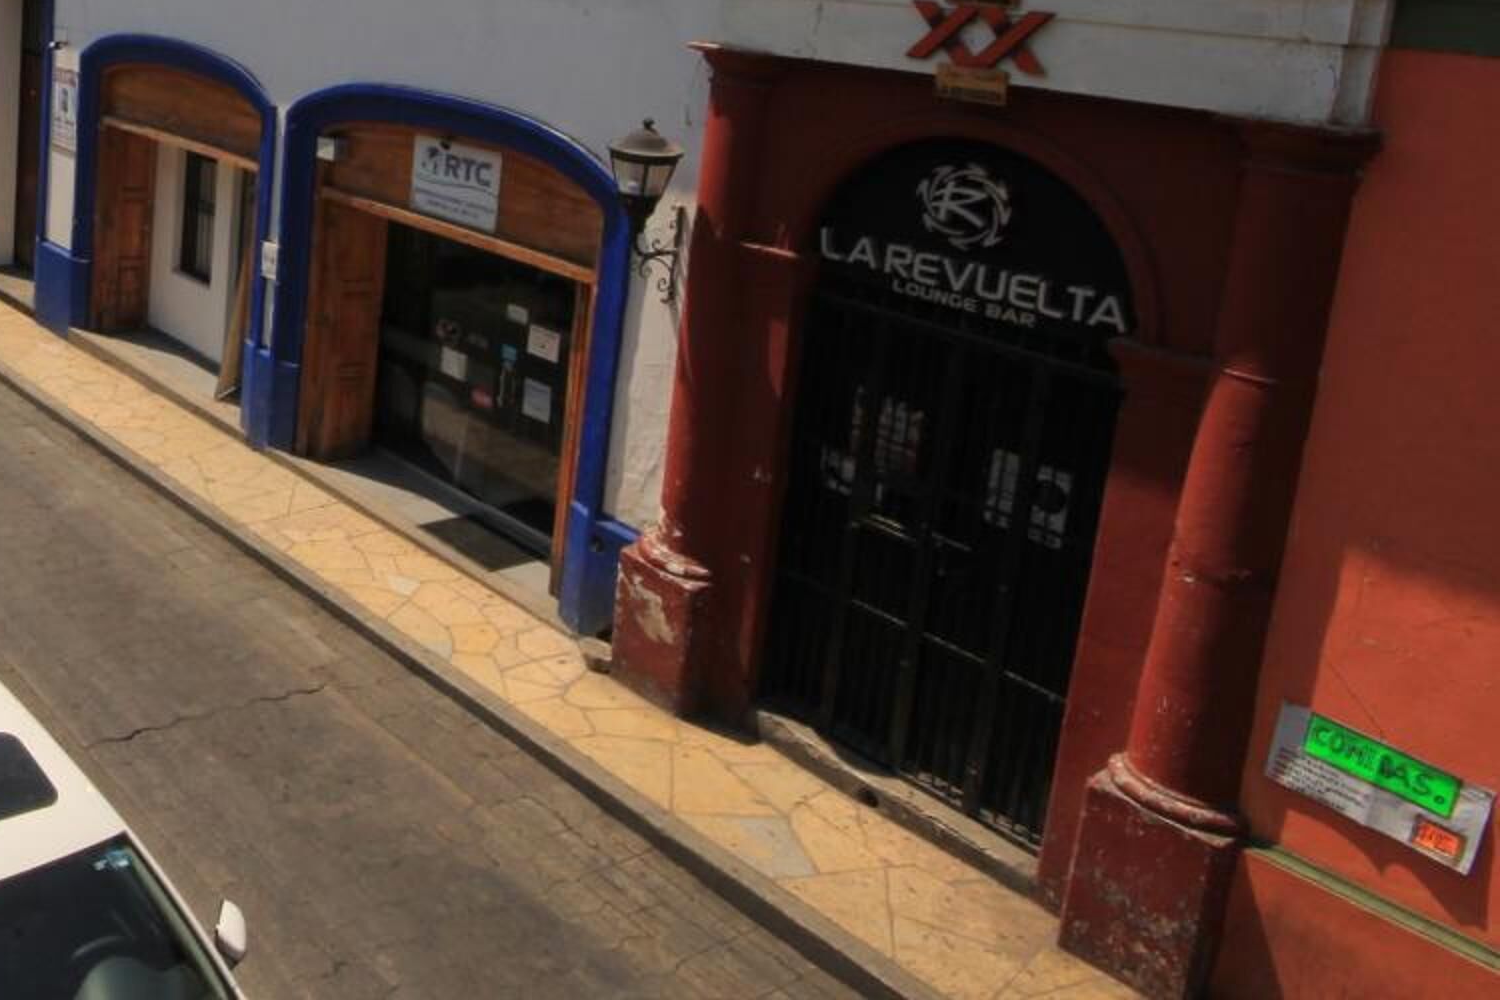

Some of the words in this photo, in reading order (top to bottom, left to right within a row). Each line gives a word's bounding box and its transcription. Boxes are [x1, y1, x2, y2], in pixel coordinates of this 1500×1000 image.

[444, 152, 492, 188] RTC
[820, 227, 876, 269] LA
[883, 244, 1126, 333] REVUELTA
[892, 279, 978, 313] LOUNGE
[985, 303, 1036, 328] BAR
